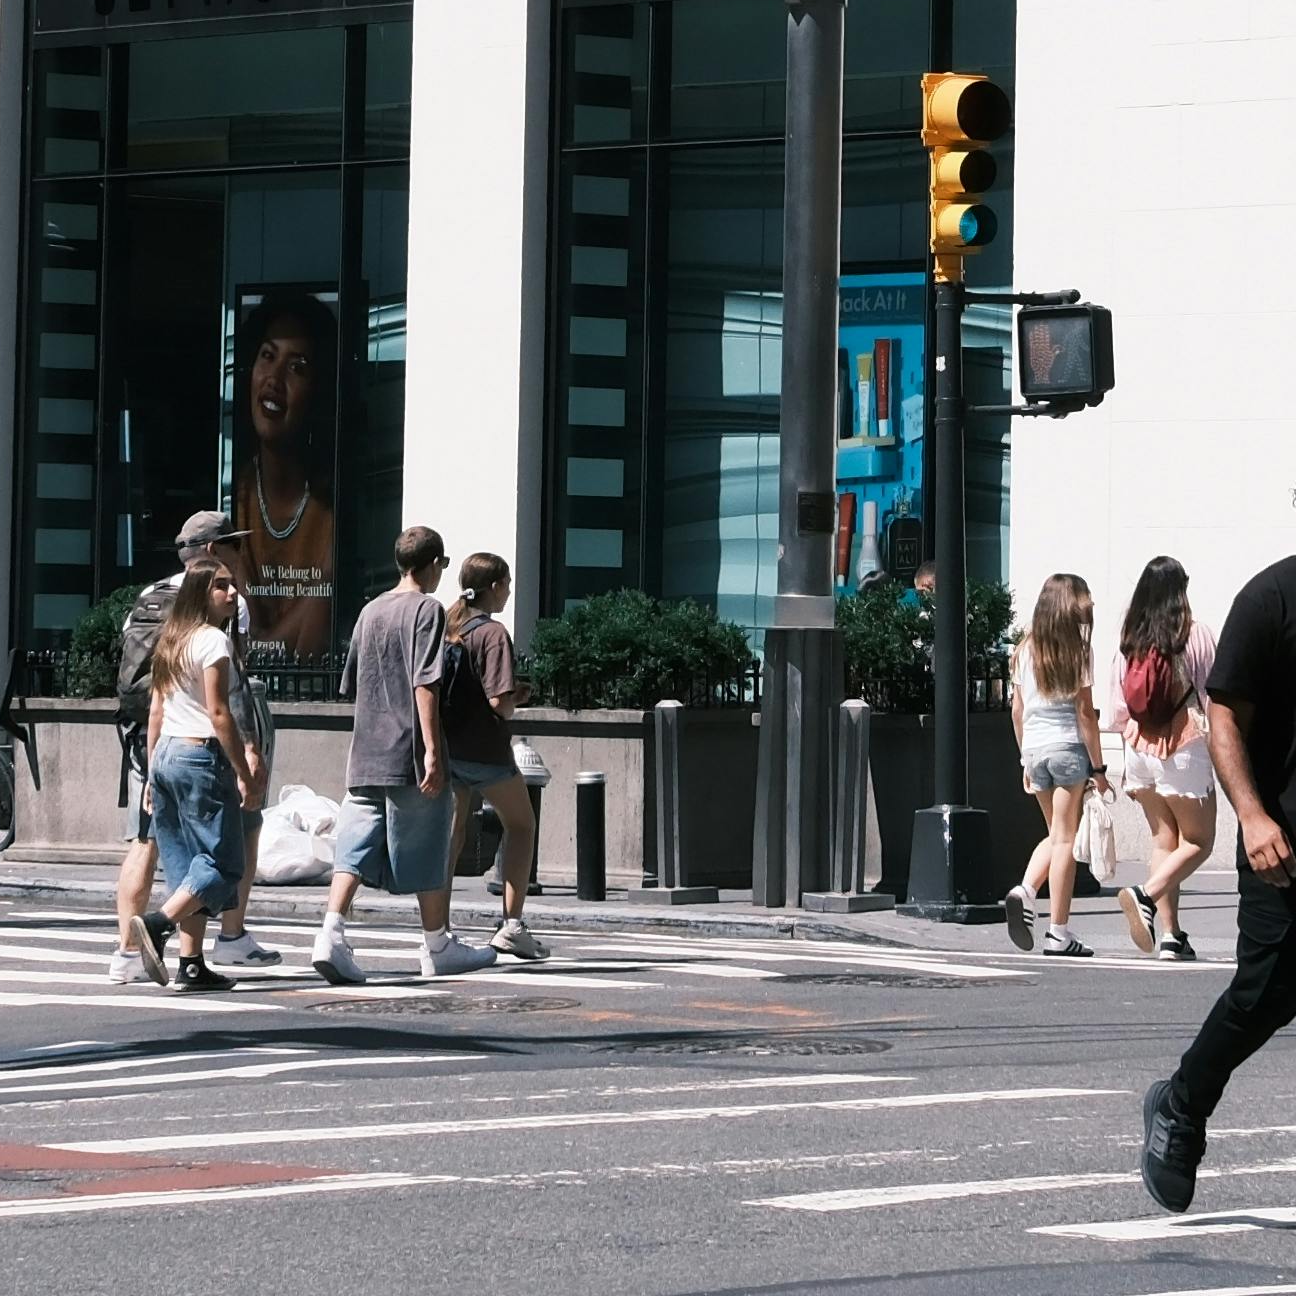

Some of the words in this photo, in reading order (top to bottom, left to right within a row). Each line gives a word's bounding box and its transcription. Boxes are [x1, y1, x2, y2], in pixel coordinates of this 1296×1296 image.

[873, 288, 892, 312] At
[896, 288, 907, 311] It
[261, 564, 275, 579] We
[278, 564, 310, 581] Belong
[311, 566, 322, 580] to
[245, 580, 295, 599] Something
